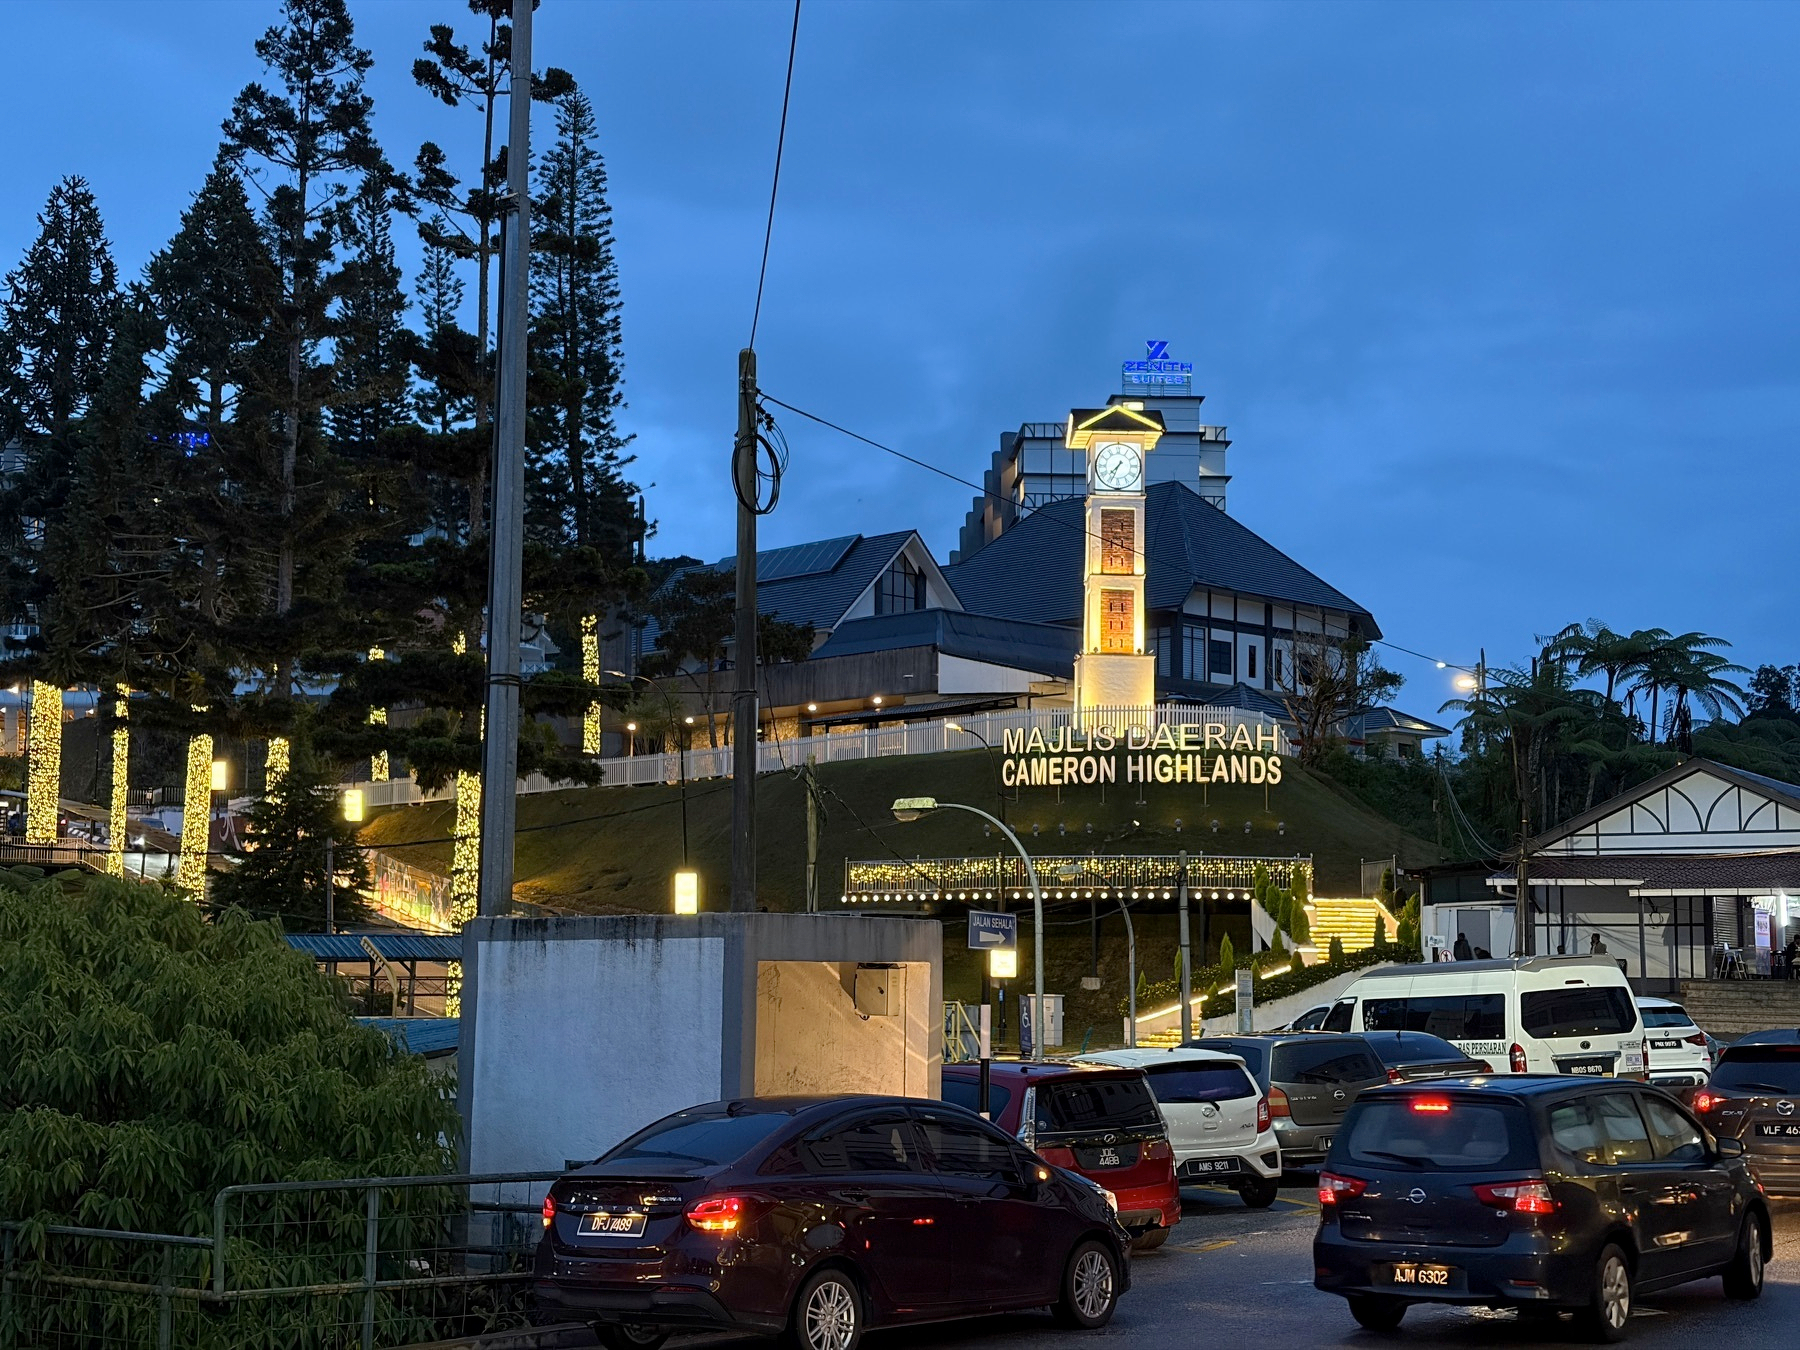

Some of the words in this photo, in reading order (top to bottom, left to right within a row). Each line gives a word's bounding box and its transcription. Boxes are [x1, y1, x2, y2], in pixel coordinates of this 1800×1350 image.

[1124, 361, 1193, 372] ZENITH
[1132, 375, 1185, 384] SUITES
[1003, 724, 1117, 755] MAJLIS
[1127, 723, 1279, 752] DAERAH
[1002, 755, 1116, 786] CAMERON
[1126, 753, 1282, 785] HIGHLANDS
[973, 916, 990, 928] JALAN
[992, 917, 1012, 930] SEHALA
[1458, 1042, 1470, 1055] BAS
[1471, 1042, 1507, 1055] PERSIARAN
[1763, 1125, 1781, 1135] VLF
[1198, 1162, 1213, 1172] AMS
[1214, 1161, 1229, 1171] 9211
[591, 1217, 610, 1231] DFJ
[610, 1218, 632, 1232] 7489
[1394, 1268, 1415, 1283] AJM
[1418, 1270, 1448, 1285] 6302
